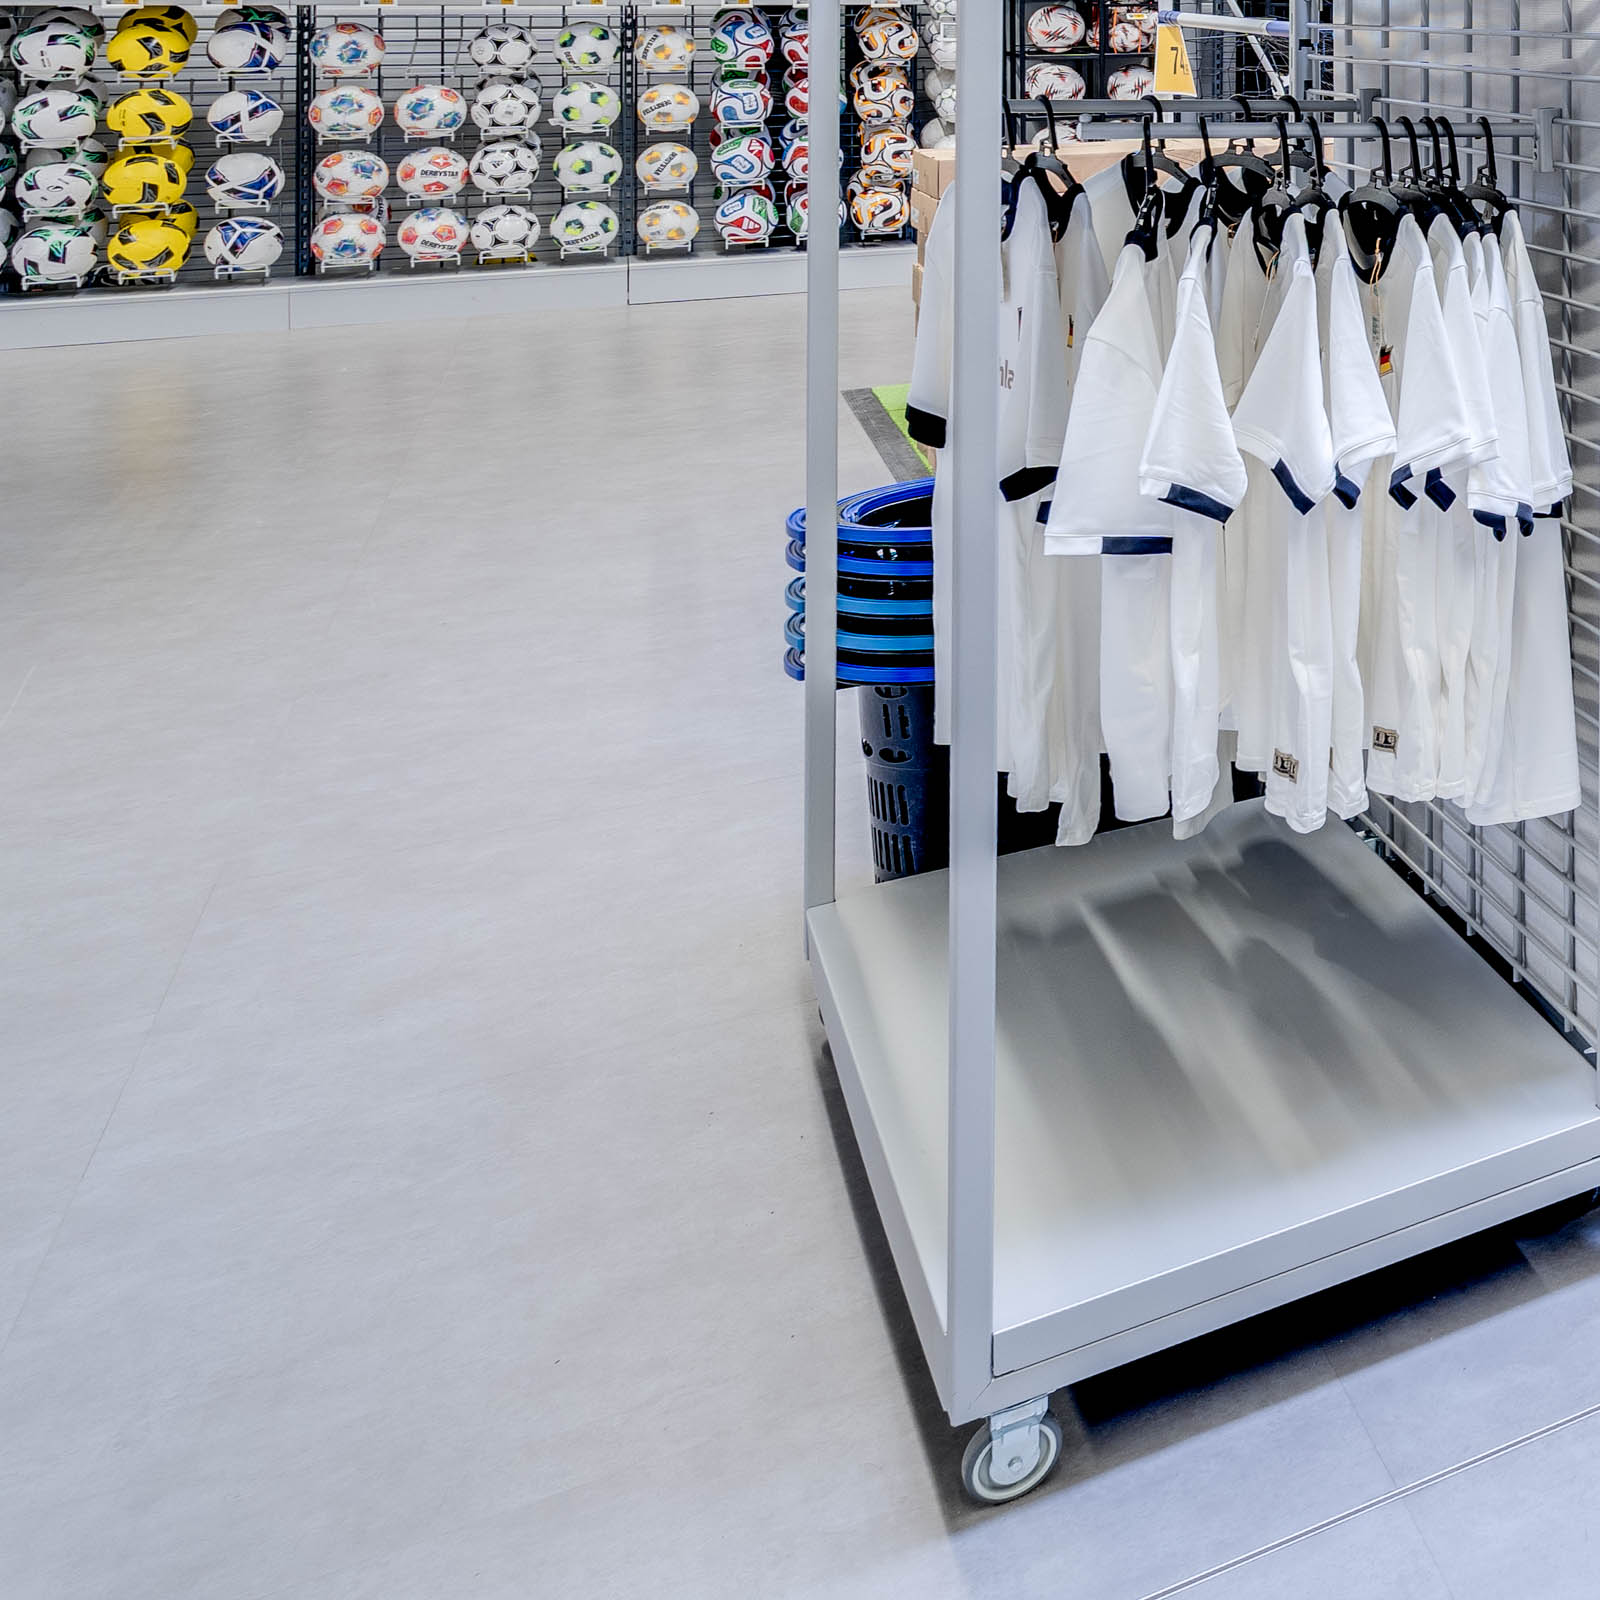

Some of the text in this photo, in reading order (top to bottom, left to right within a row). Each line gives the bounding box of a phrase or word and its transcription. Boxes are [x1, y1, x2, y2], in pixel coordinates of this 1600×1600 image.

[641, 98, 673, 117] DERBYSTAR
[420, 169, 459, 178] DERBYSTAR
[420, 238, 458, 250] DERBYSTAR
[564, 230, 600, 246] DERBYSTAR
